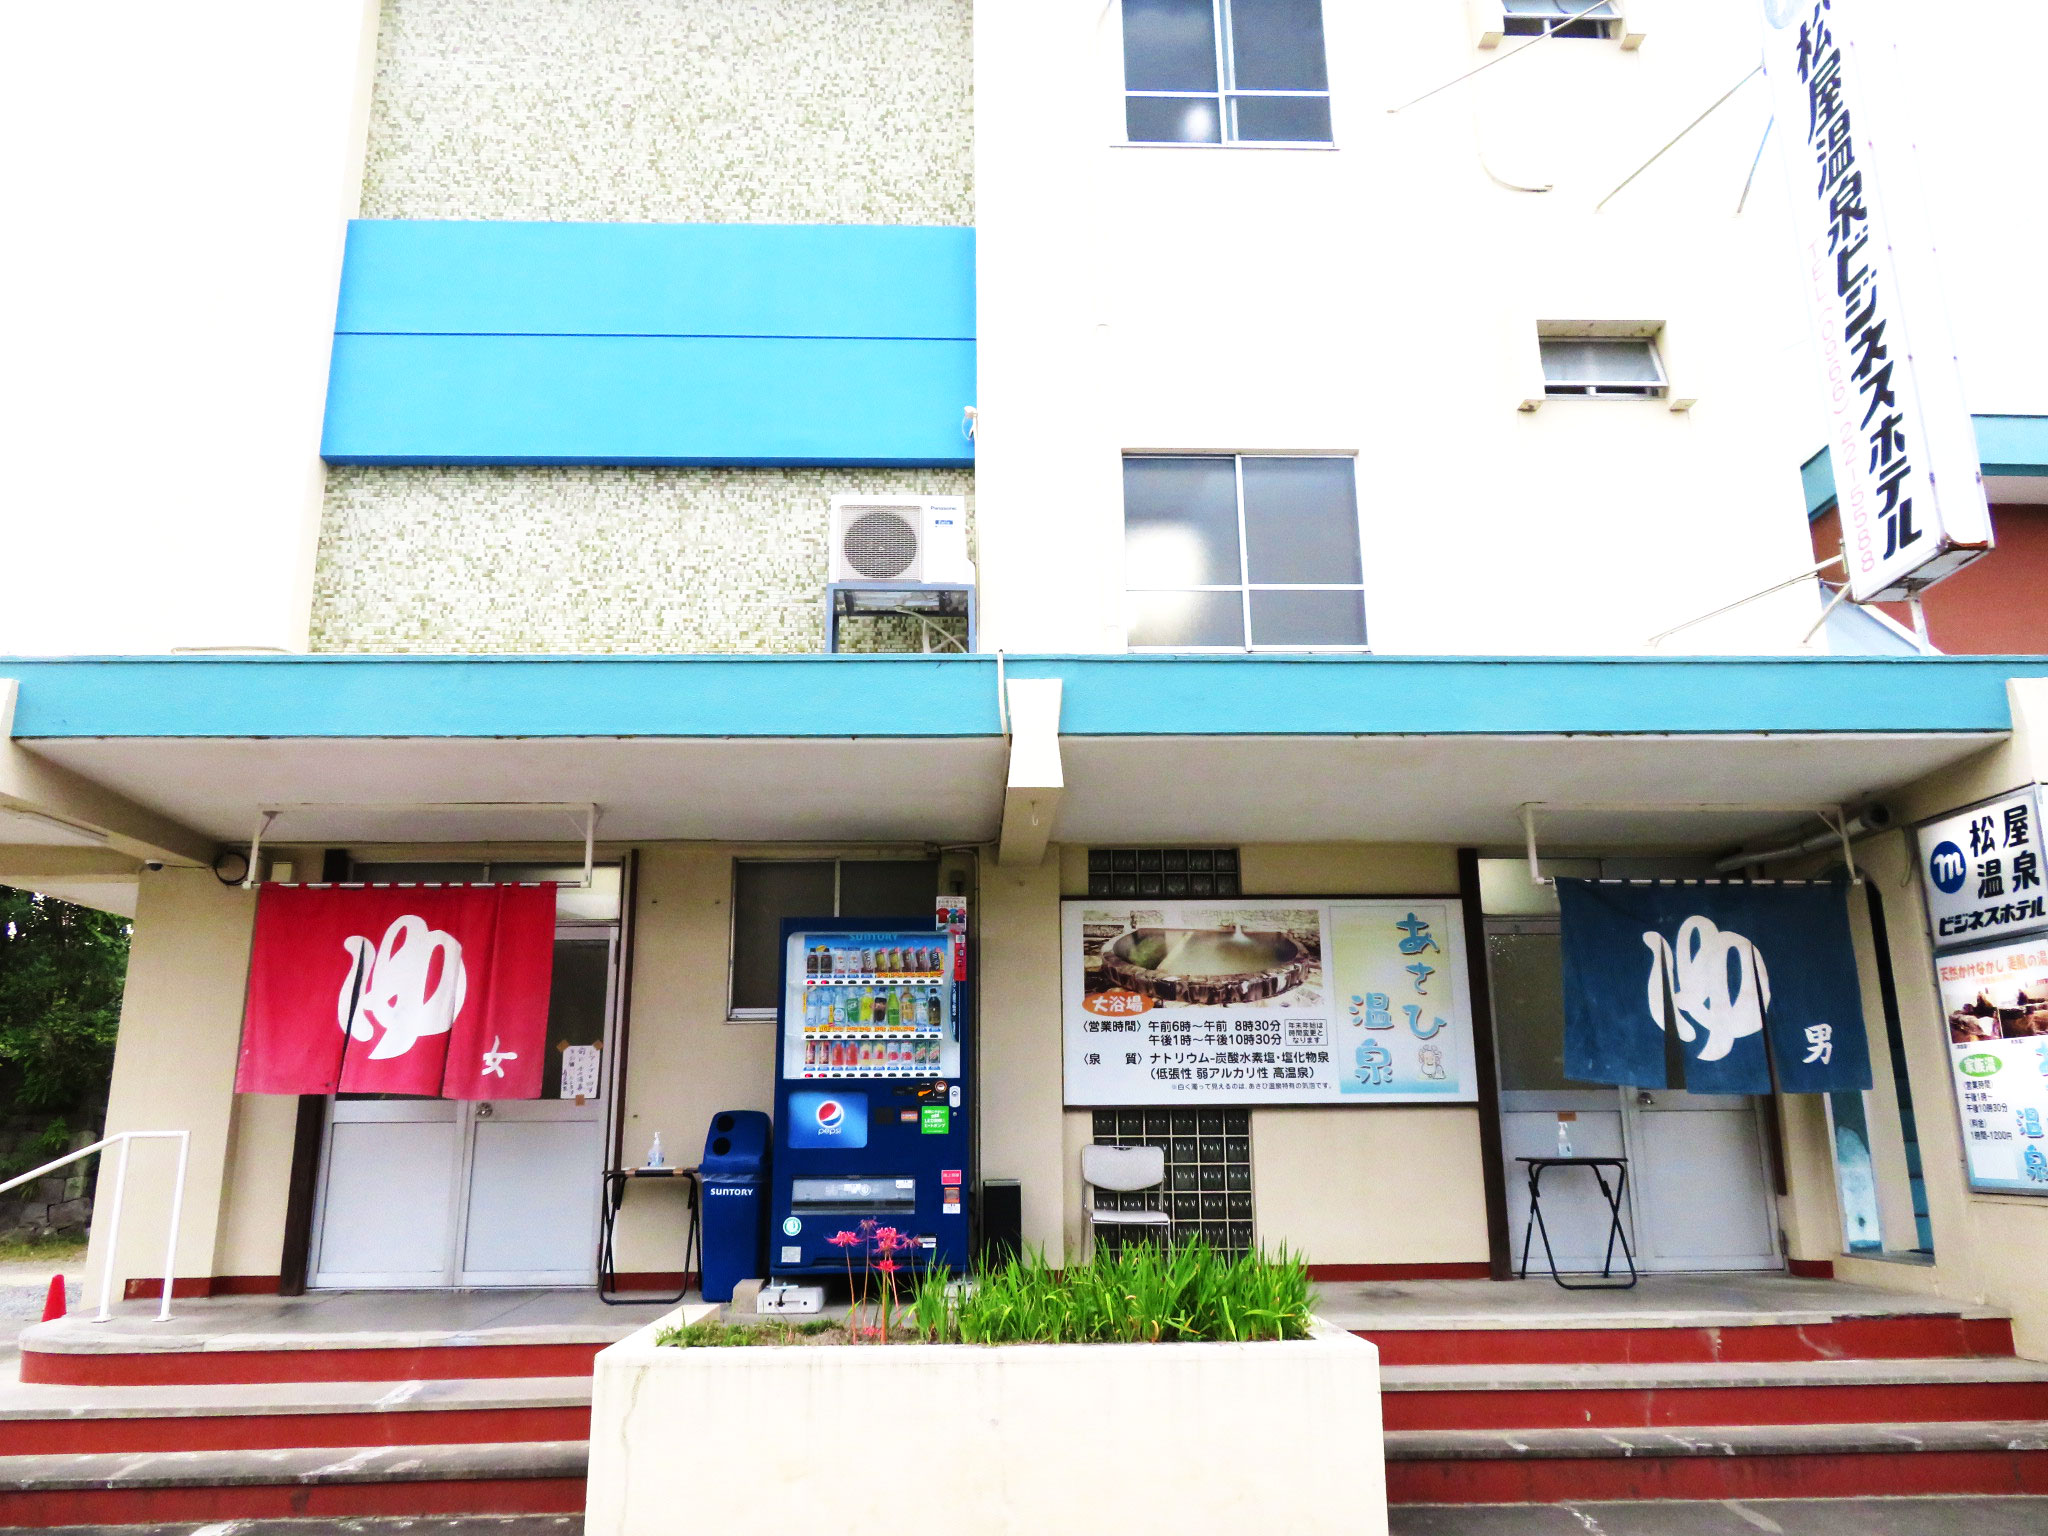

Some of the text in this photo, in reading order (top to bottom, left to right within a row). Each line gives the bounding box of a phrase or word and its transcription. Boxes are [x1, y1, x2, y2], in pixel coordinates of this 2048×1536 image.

[1796, 0, 1922, 560] 松屋温泉ビジネスホテル
[1969, 804, 2029, 857] 松屋
[1977, 850, 2040, 899] 温泉
[1939, 896, 2046, 936] ビジネスホテル
[337, 914, 467, 1060] ゆ
[1396, 912, 1447, 1040] あさひ
[1642, 915, 1771, 1061] ゆ
[1092, 995, 1143, 1012] 大浴場
[482, 1035, 517, 1078] 女
[1349, 992, 1394, 1085] 温泉
[1802, 1023, 1832, 1064] 男
[817, 1127, 842, 1136] pepsi
[710, 1188, 753, 1196] SUNTORY
